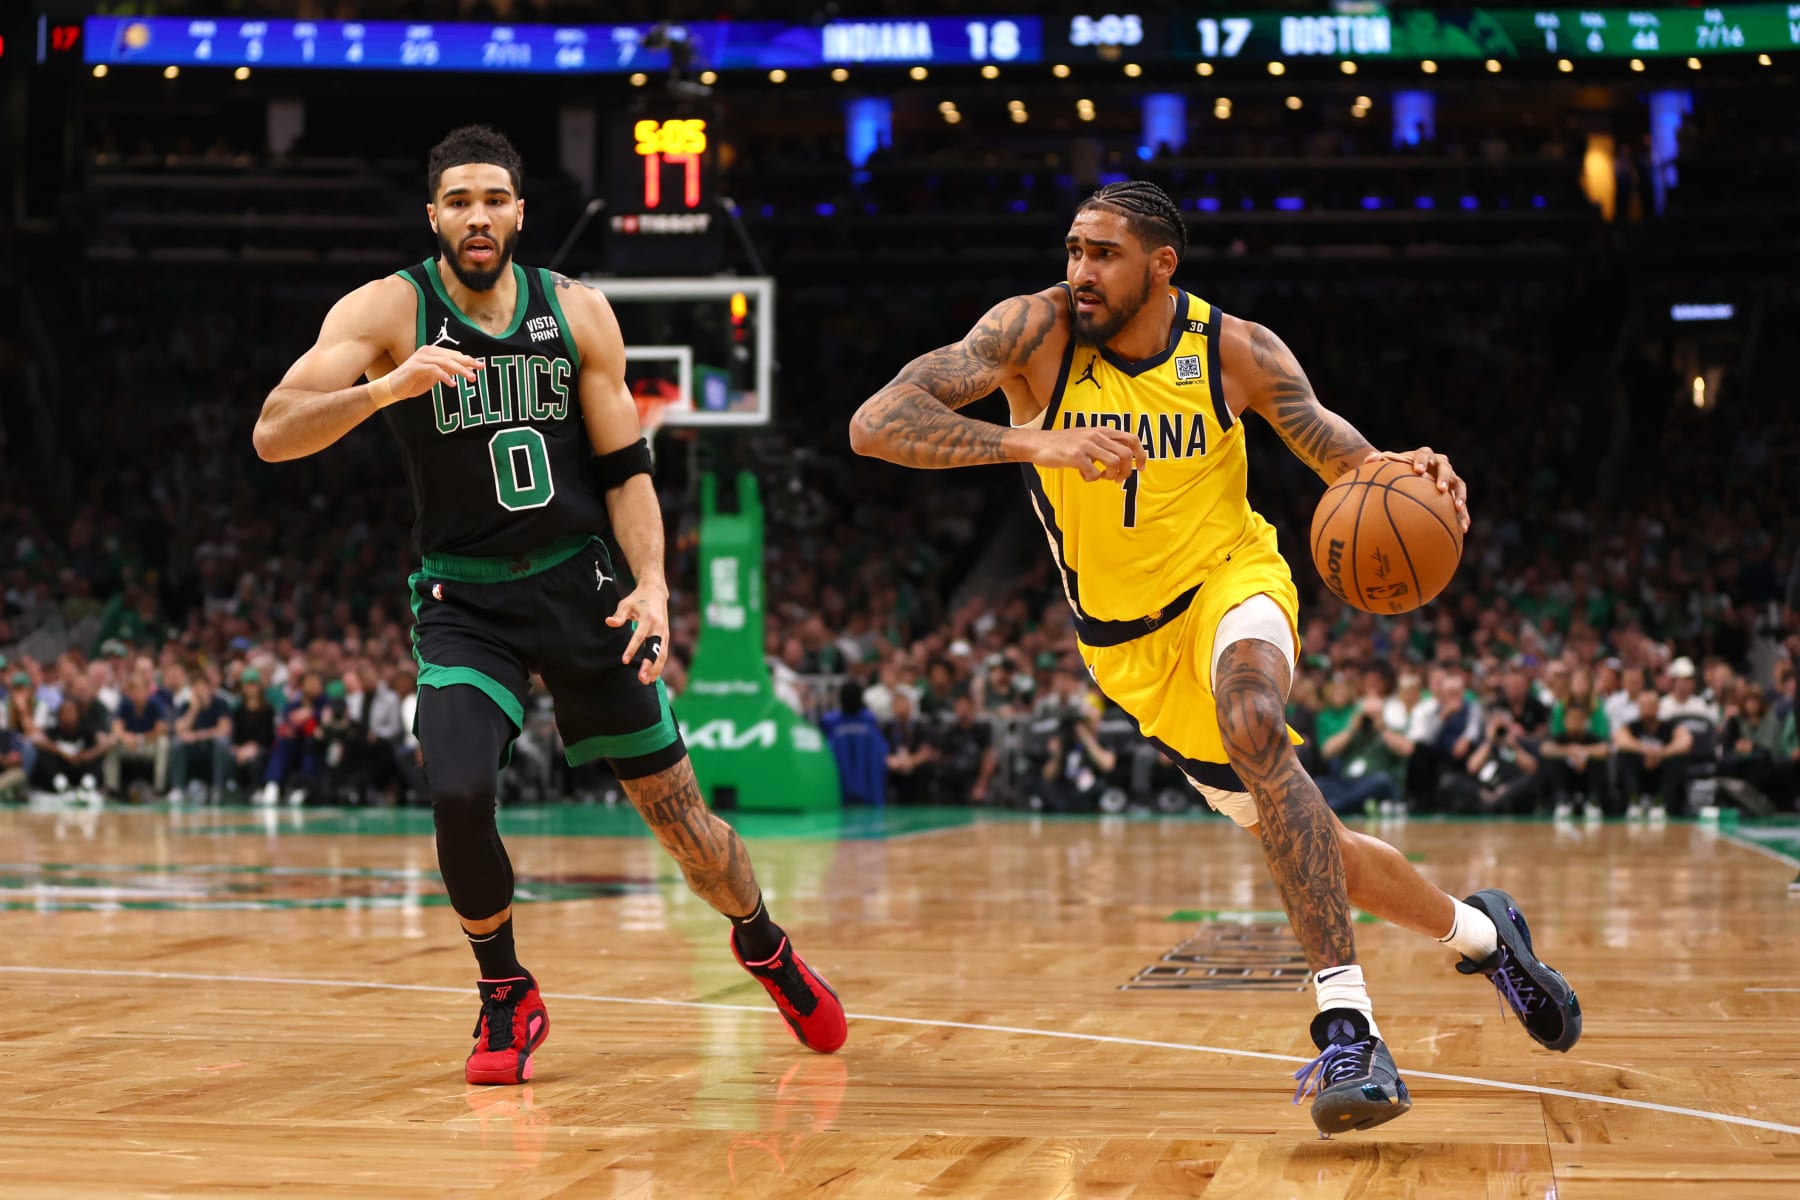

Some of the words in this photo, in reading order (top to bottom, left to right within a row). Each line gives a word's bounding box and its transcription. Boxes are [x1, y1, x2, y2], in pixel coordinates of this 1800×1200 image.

[966, 21, 1020, 60] 18
[1070, 14, 1143, 46] 5:05
[1197, 18, 1252, 57] 17
[1280, 16, 1391, 55] BOSTON
[634, 119, 706, 154] 5:05
[645, 153, 700, 208] 17
[527, 316, 557, 333] VISTA
[530, 327, 559, 343] PRINT
[1190, 322, 1203, 333] 30
[431, 354, 571, 435] CELTICS
[488, 426, 555, 511] 0
[1121, 468, 1140, 528] 1
[679, 719, 777, 750] KIA
